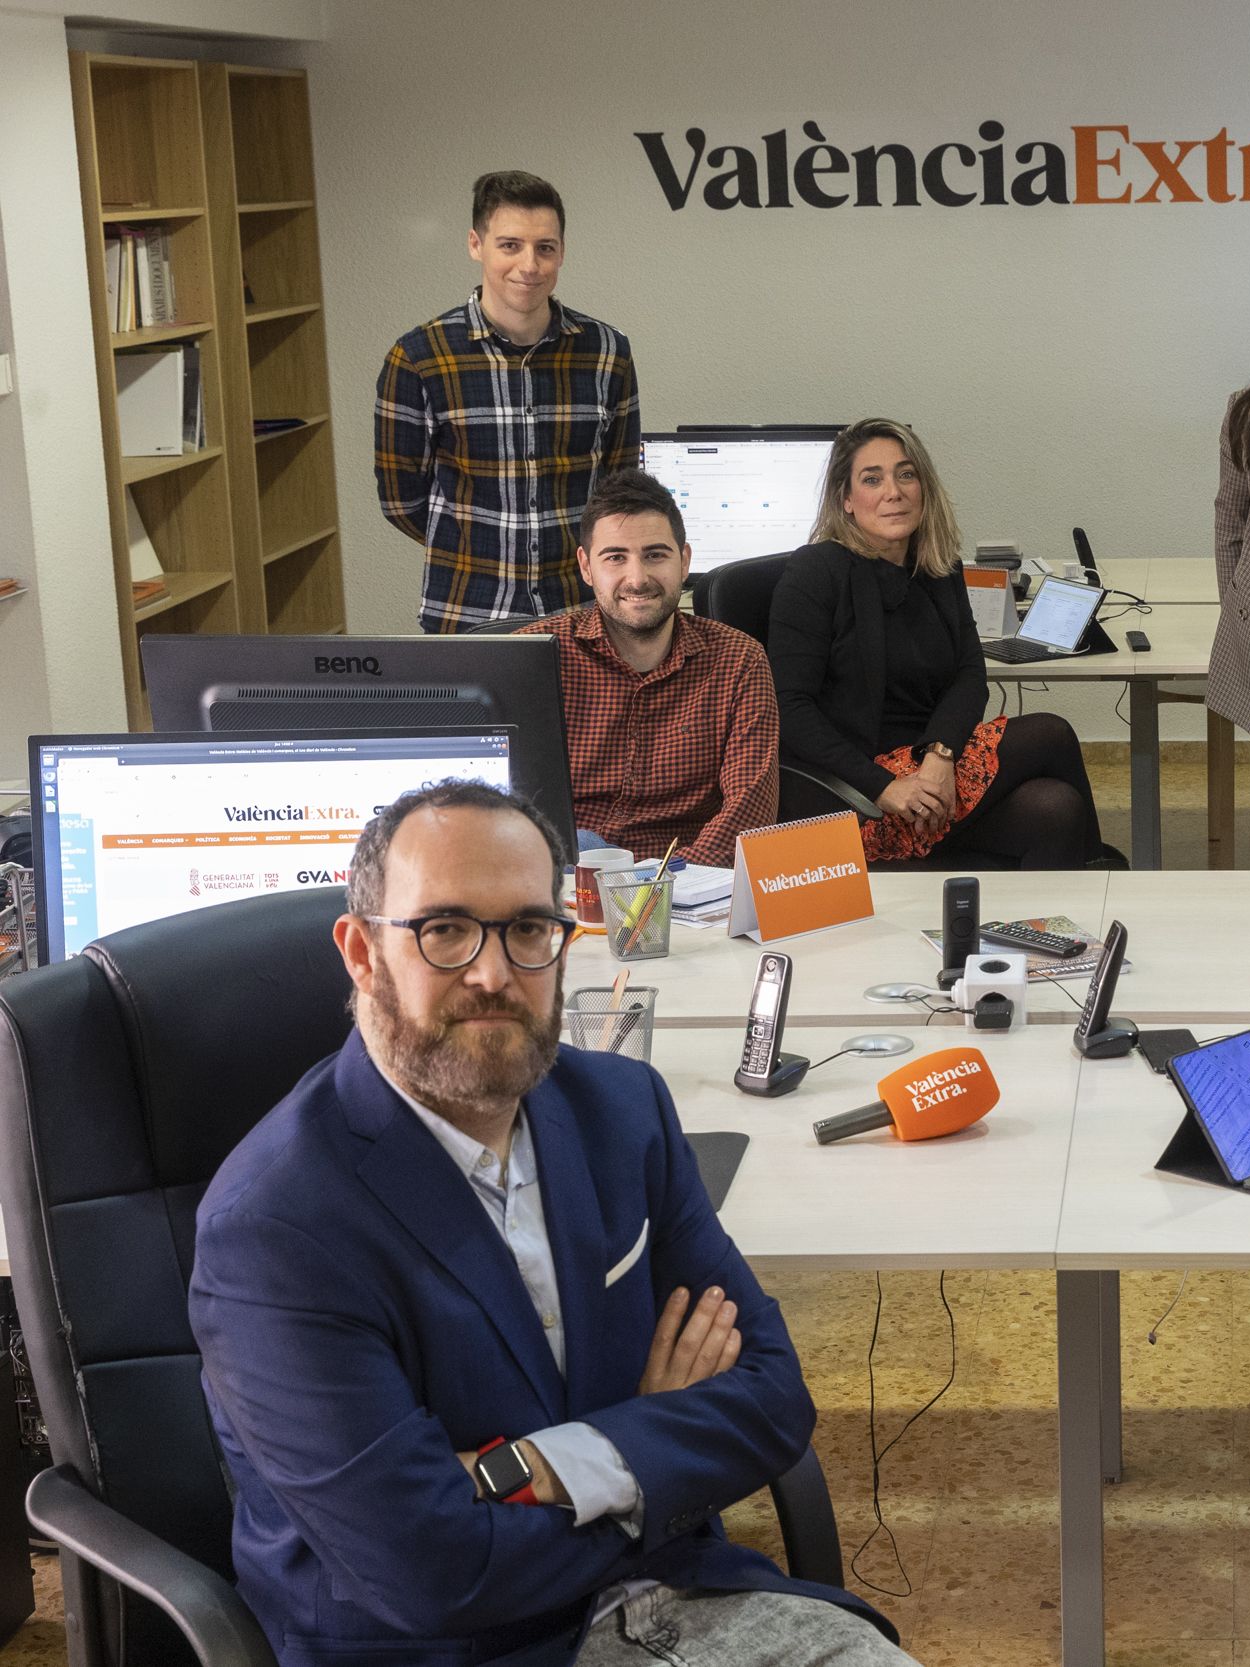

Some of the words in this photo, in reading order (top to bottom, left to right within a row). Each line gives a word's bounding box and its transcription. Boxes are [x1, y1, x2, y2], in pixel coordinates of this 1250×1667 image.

[314, 656, 382, 677] BenQ
[224, 805, 360, 822] ValènciaExtra.
[203, 873, 255, 882] GENERALITAT
[204, 881, 255, 890] VALENCIANA
[757, 862, 861, 895] ValènciaExtra.
[904, 1060, 982, 1097] València
[911, 1083, 968, 1113] Extra.
